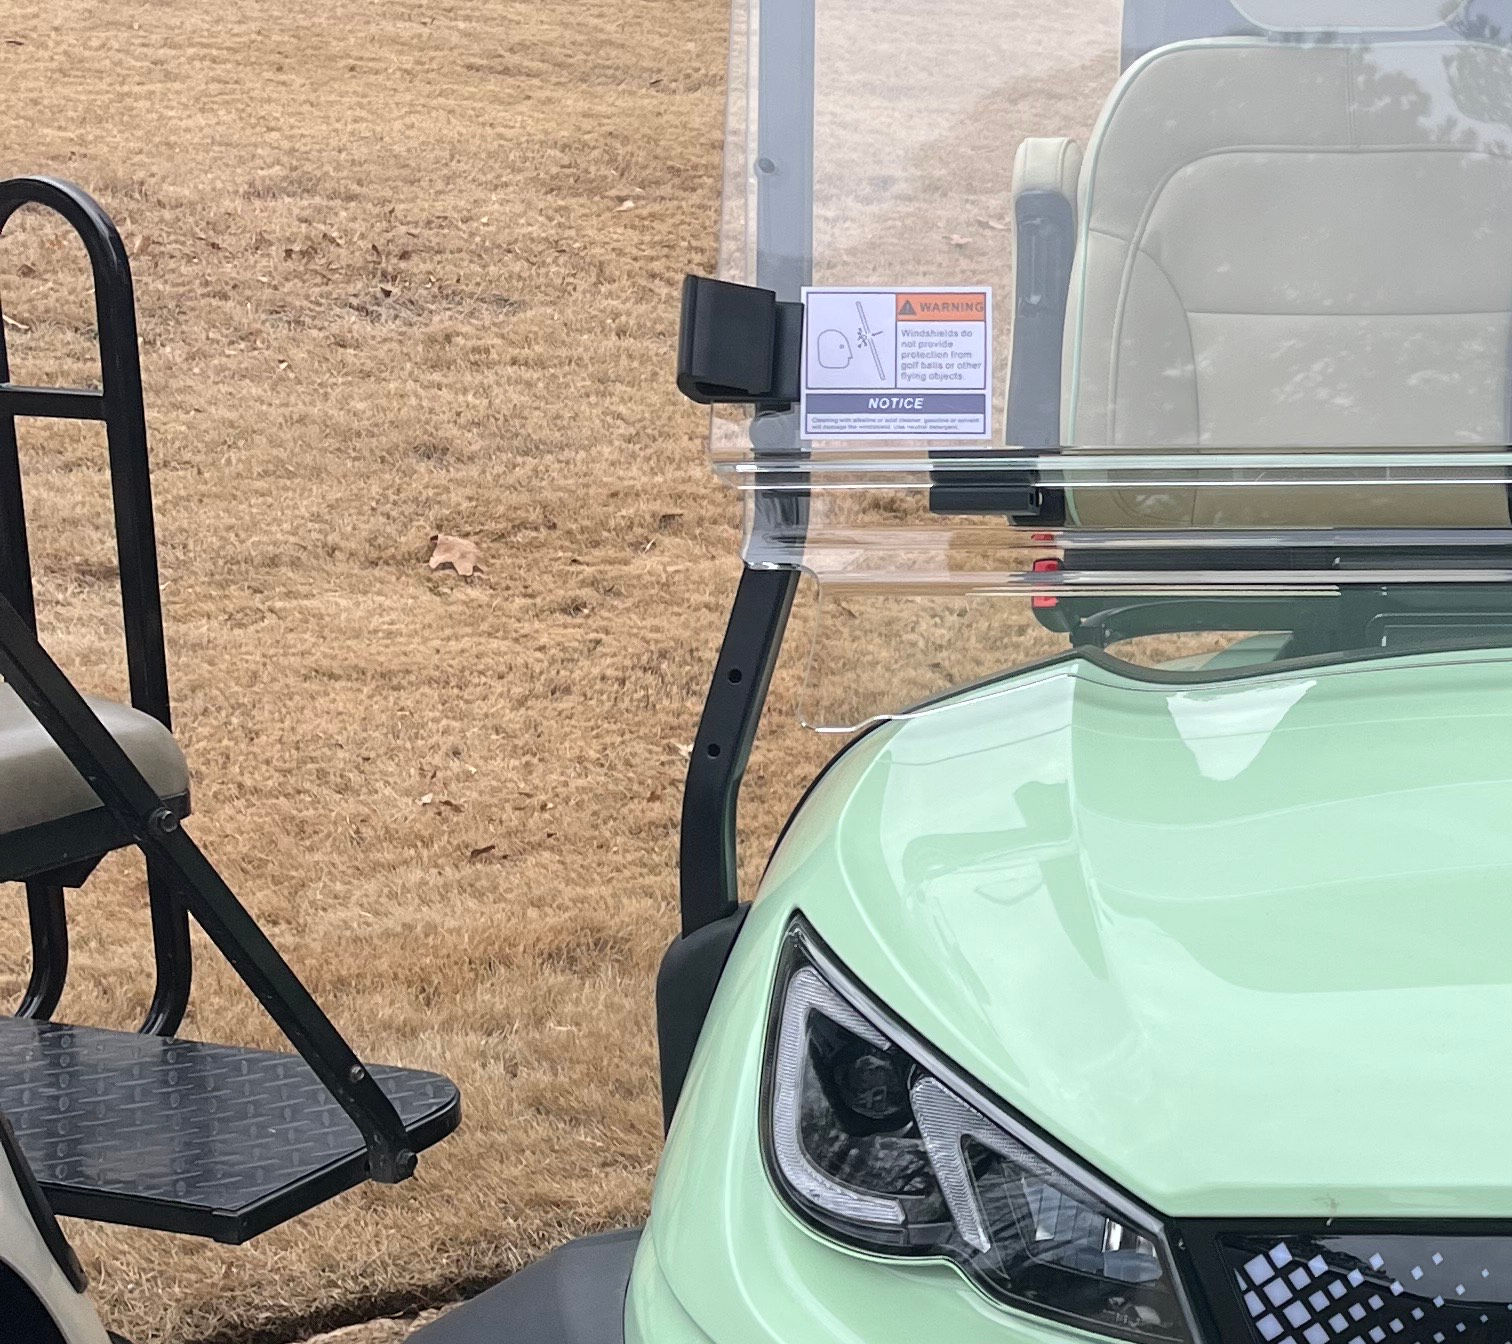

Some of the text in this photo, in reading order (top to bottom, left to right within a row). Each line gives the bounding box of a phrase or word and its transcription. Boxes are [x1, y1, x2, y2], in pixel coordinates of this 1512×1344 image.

[920, 301, 984, 313] WARNING
[901, 329, 959, 337] Windshields
[901, 340, 954, 349] not provide
[901, 351, 972, 360] protection from
[901, 362, 919, 371] golf
[901, 372, 927, 382] flying
[868, 397, 925, 408] NOTICE
